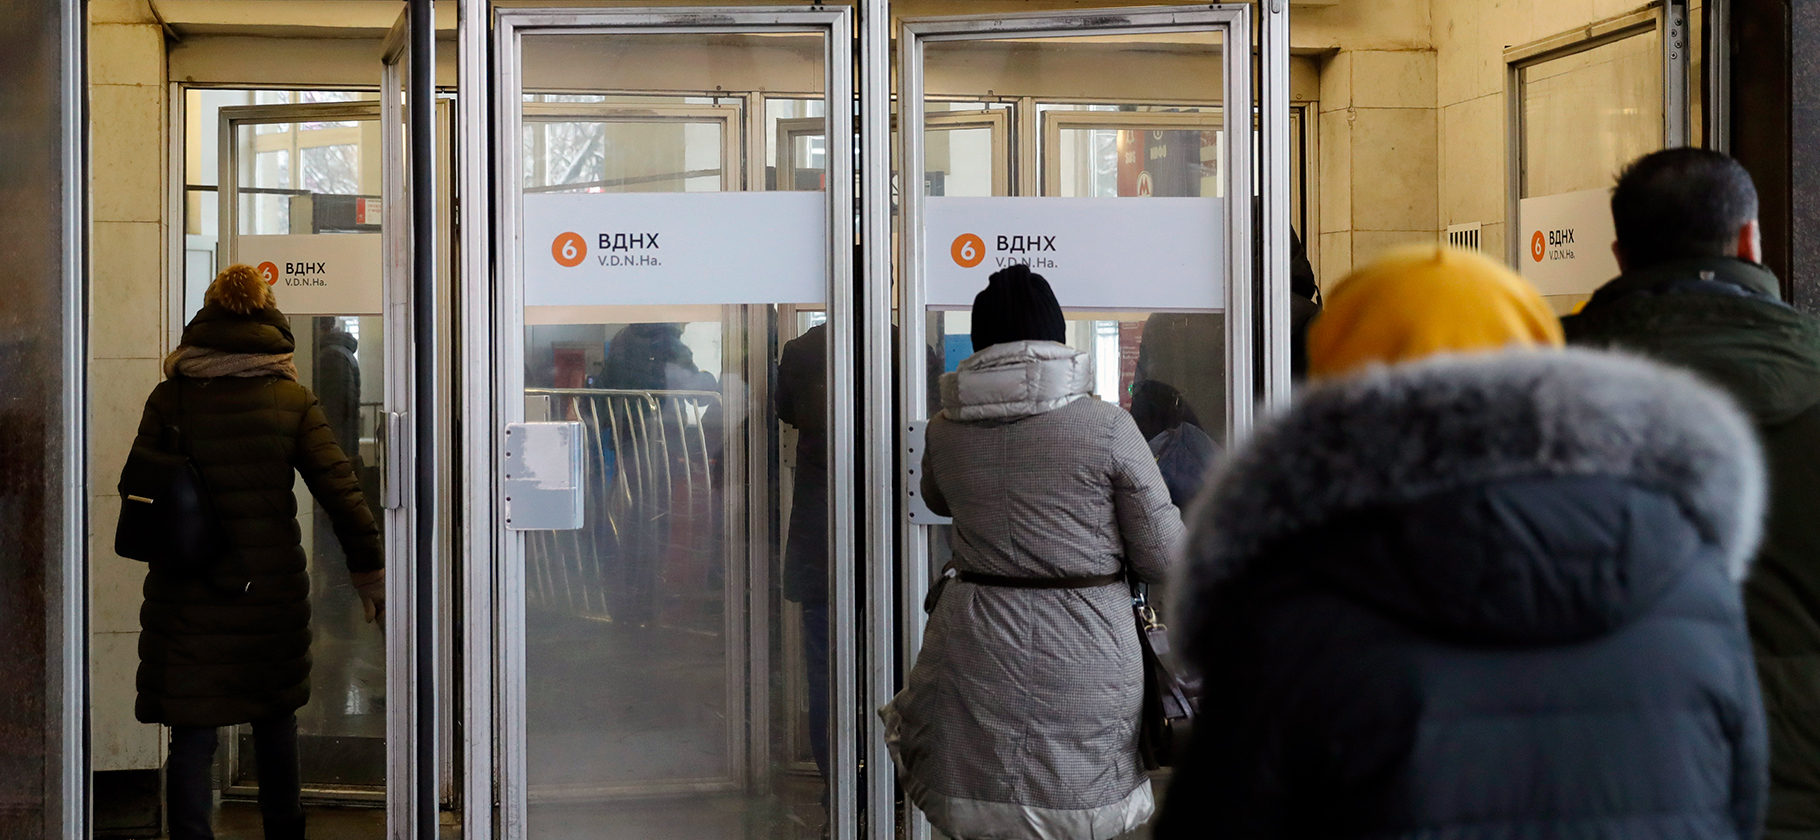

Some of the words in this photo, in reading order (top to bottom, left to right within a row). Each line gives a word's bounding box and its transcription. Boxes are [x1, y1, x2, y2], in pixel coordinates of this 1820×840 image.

[598, 232, 660, 252] ВДНХ
[996, 234, 1057, 254] ВДНХ
[1534, 237, 1542, 256] 6
[1549, 228, 1575, 247] ВДНХ
[561, 239, 578, 260] 6
[960, 240, 976, 261] 6
[285, 262, 326, 276] ВДНХ
[597, 254, 662, 266] V.D.N.Ha.
[995, 256, 1058, 268] V.DN.Ha.
[262, 266, 273, 281] 6
[284, 278, 328, 287] V.D.N.Ha.
